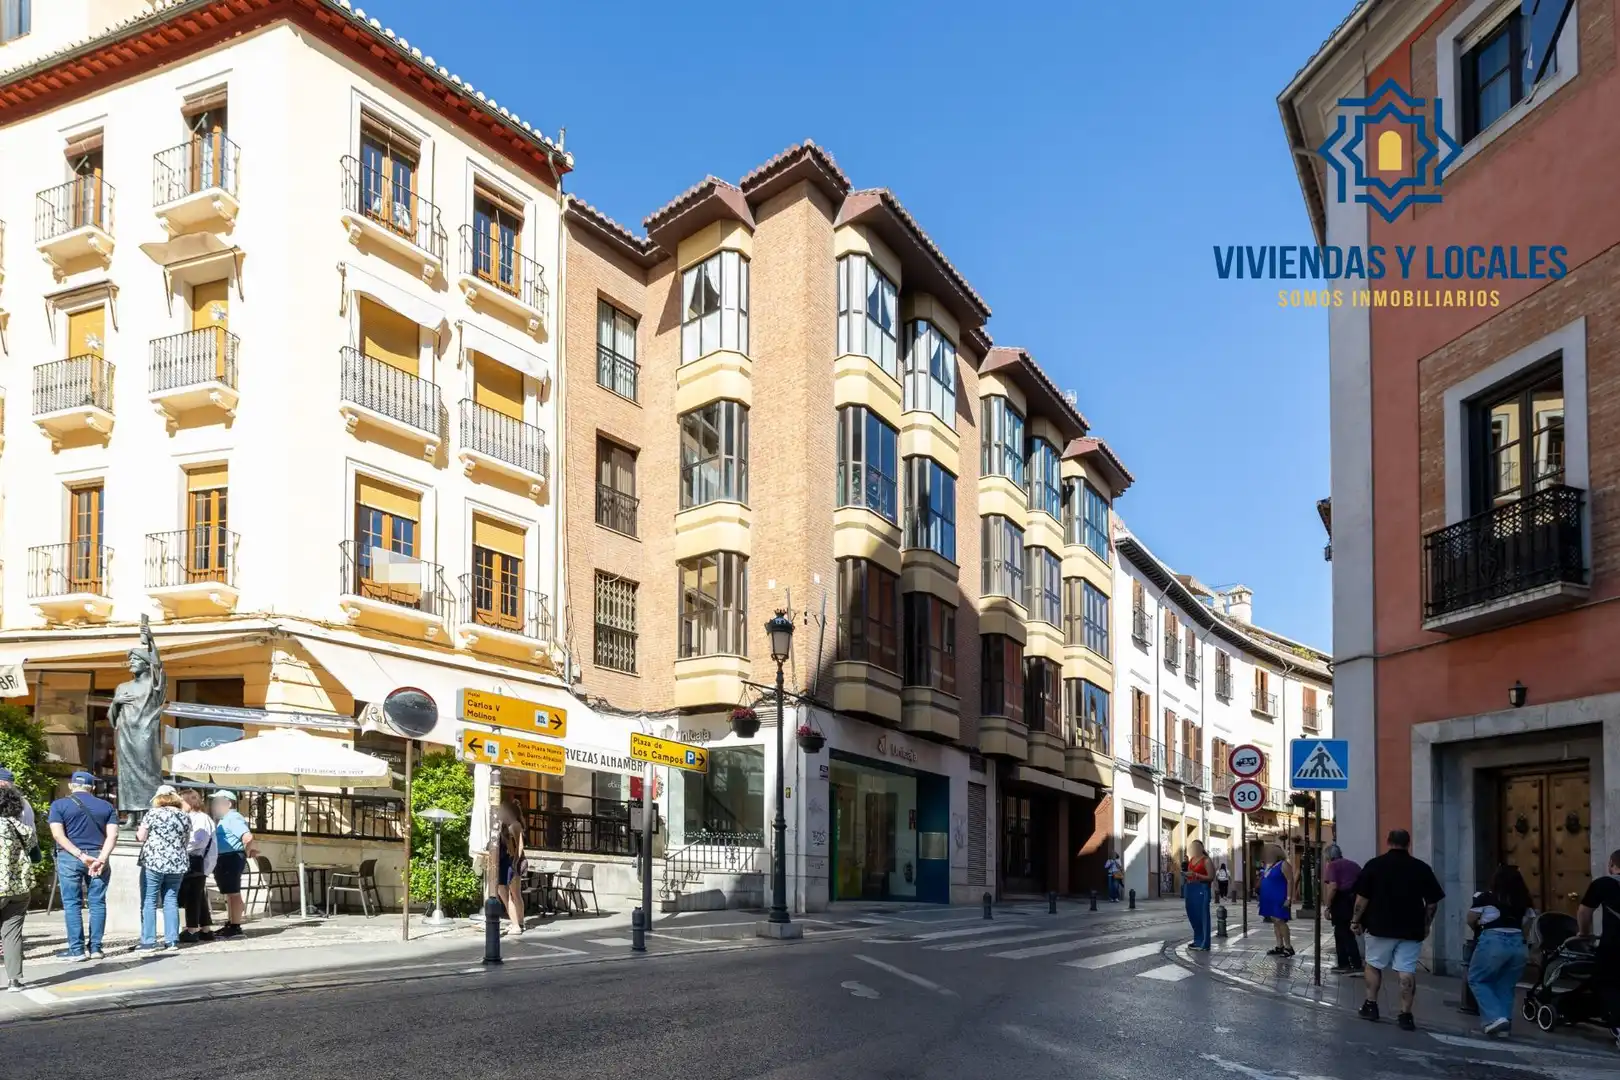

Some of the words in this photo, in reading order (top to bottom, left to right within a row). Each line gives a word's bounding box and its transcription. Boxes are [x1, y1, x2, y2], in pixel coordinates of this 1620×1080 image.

[467, 700, 493, 711] Carlos
[495, 704, 501, 712] V
[467, 709, 497, 721] Molinos
[633, 737, 651, 748] Plaza
[654, 741, 663, 749] de
[633, 747, 648, 757] Los
[651, 750, 684, 765] Campos
[600, 754, 647, 774] ALHAMBR
[1238, 791, 1257, 802] 30
